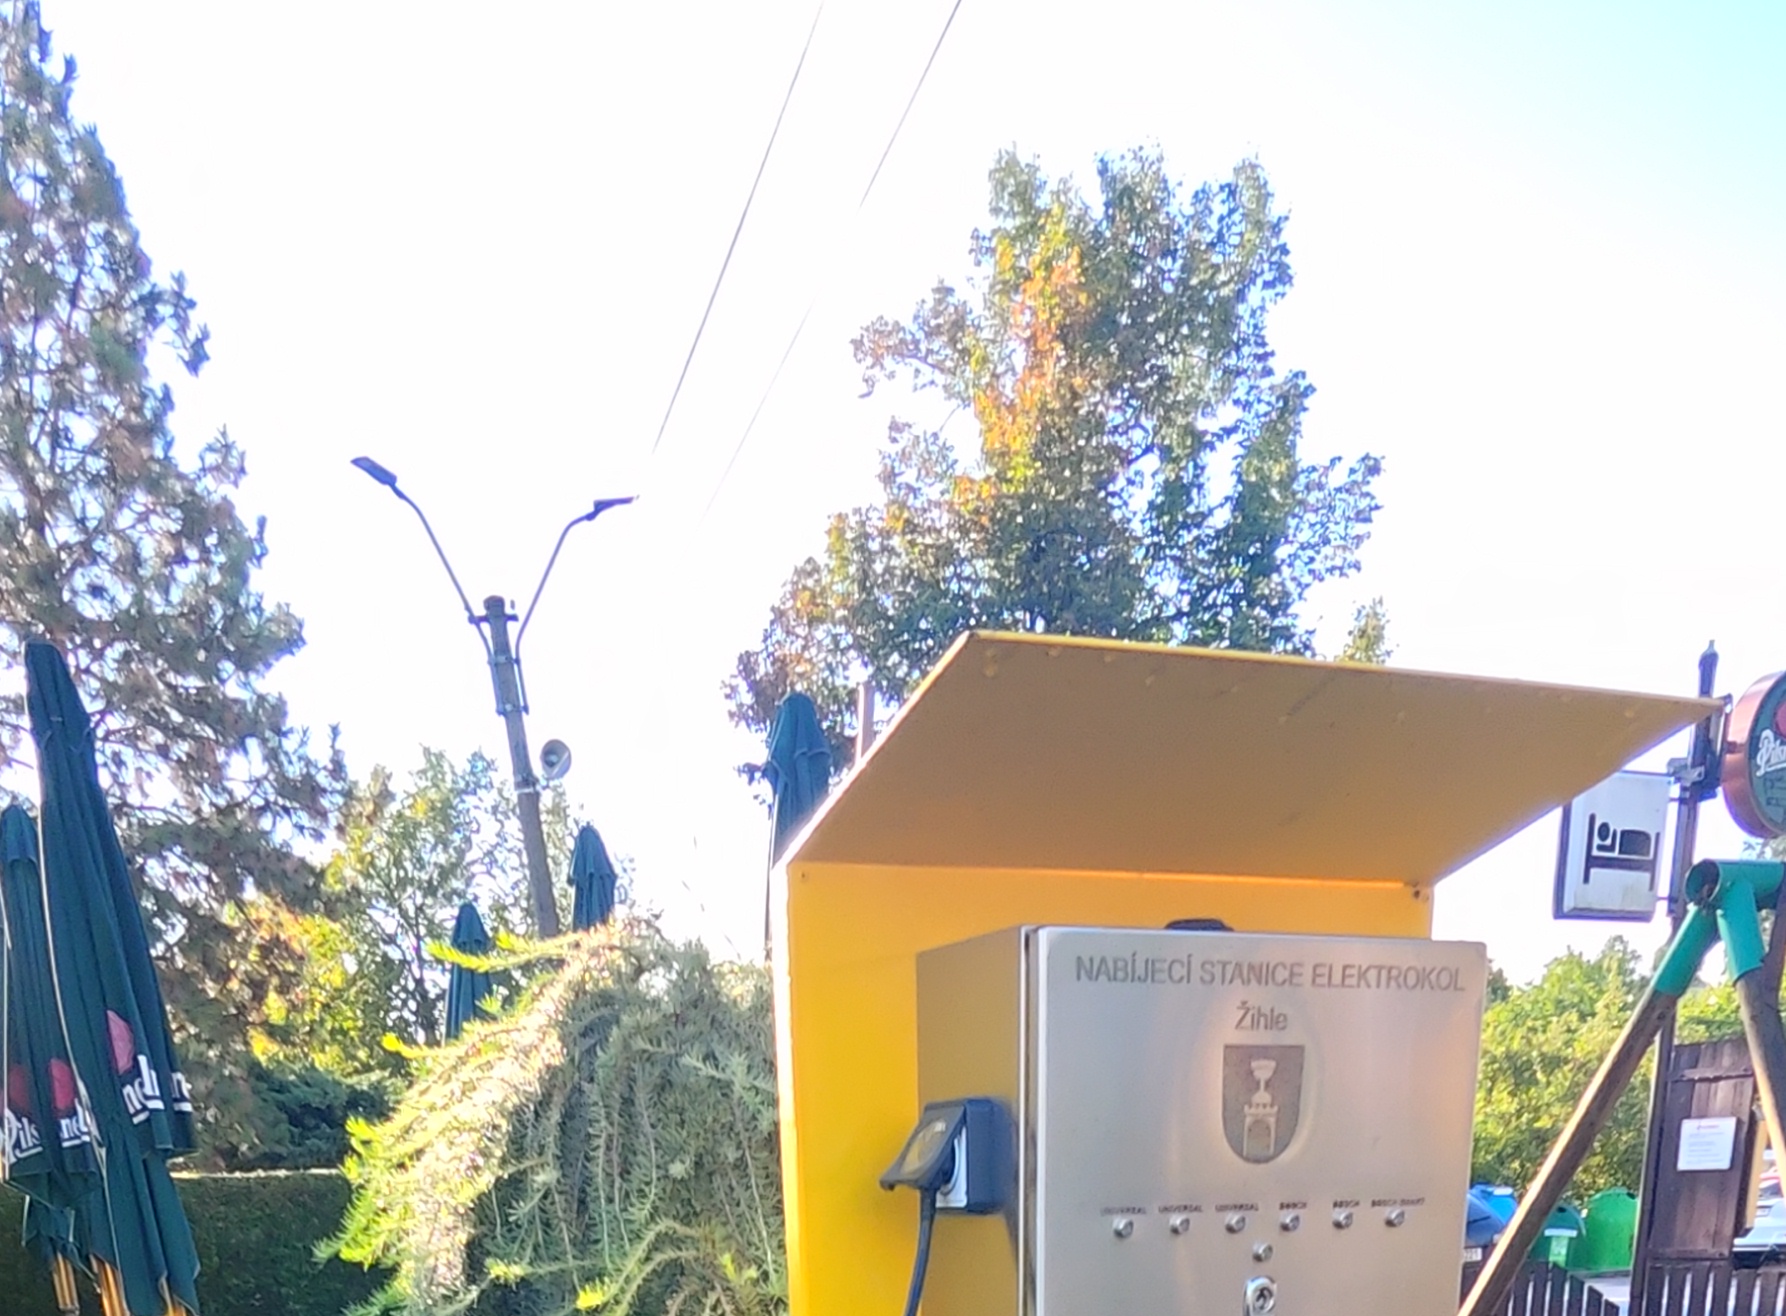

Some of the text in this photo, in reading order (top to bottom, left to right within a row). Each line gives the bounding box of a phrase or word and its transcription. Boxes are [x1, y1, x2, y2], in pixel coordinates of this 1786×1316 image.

[1075, 951, 1466, 992] NABÍJECÍ STANICE ELEKTROKOL
[1234, 1000, 1288, 1032] Žihle
